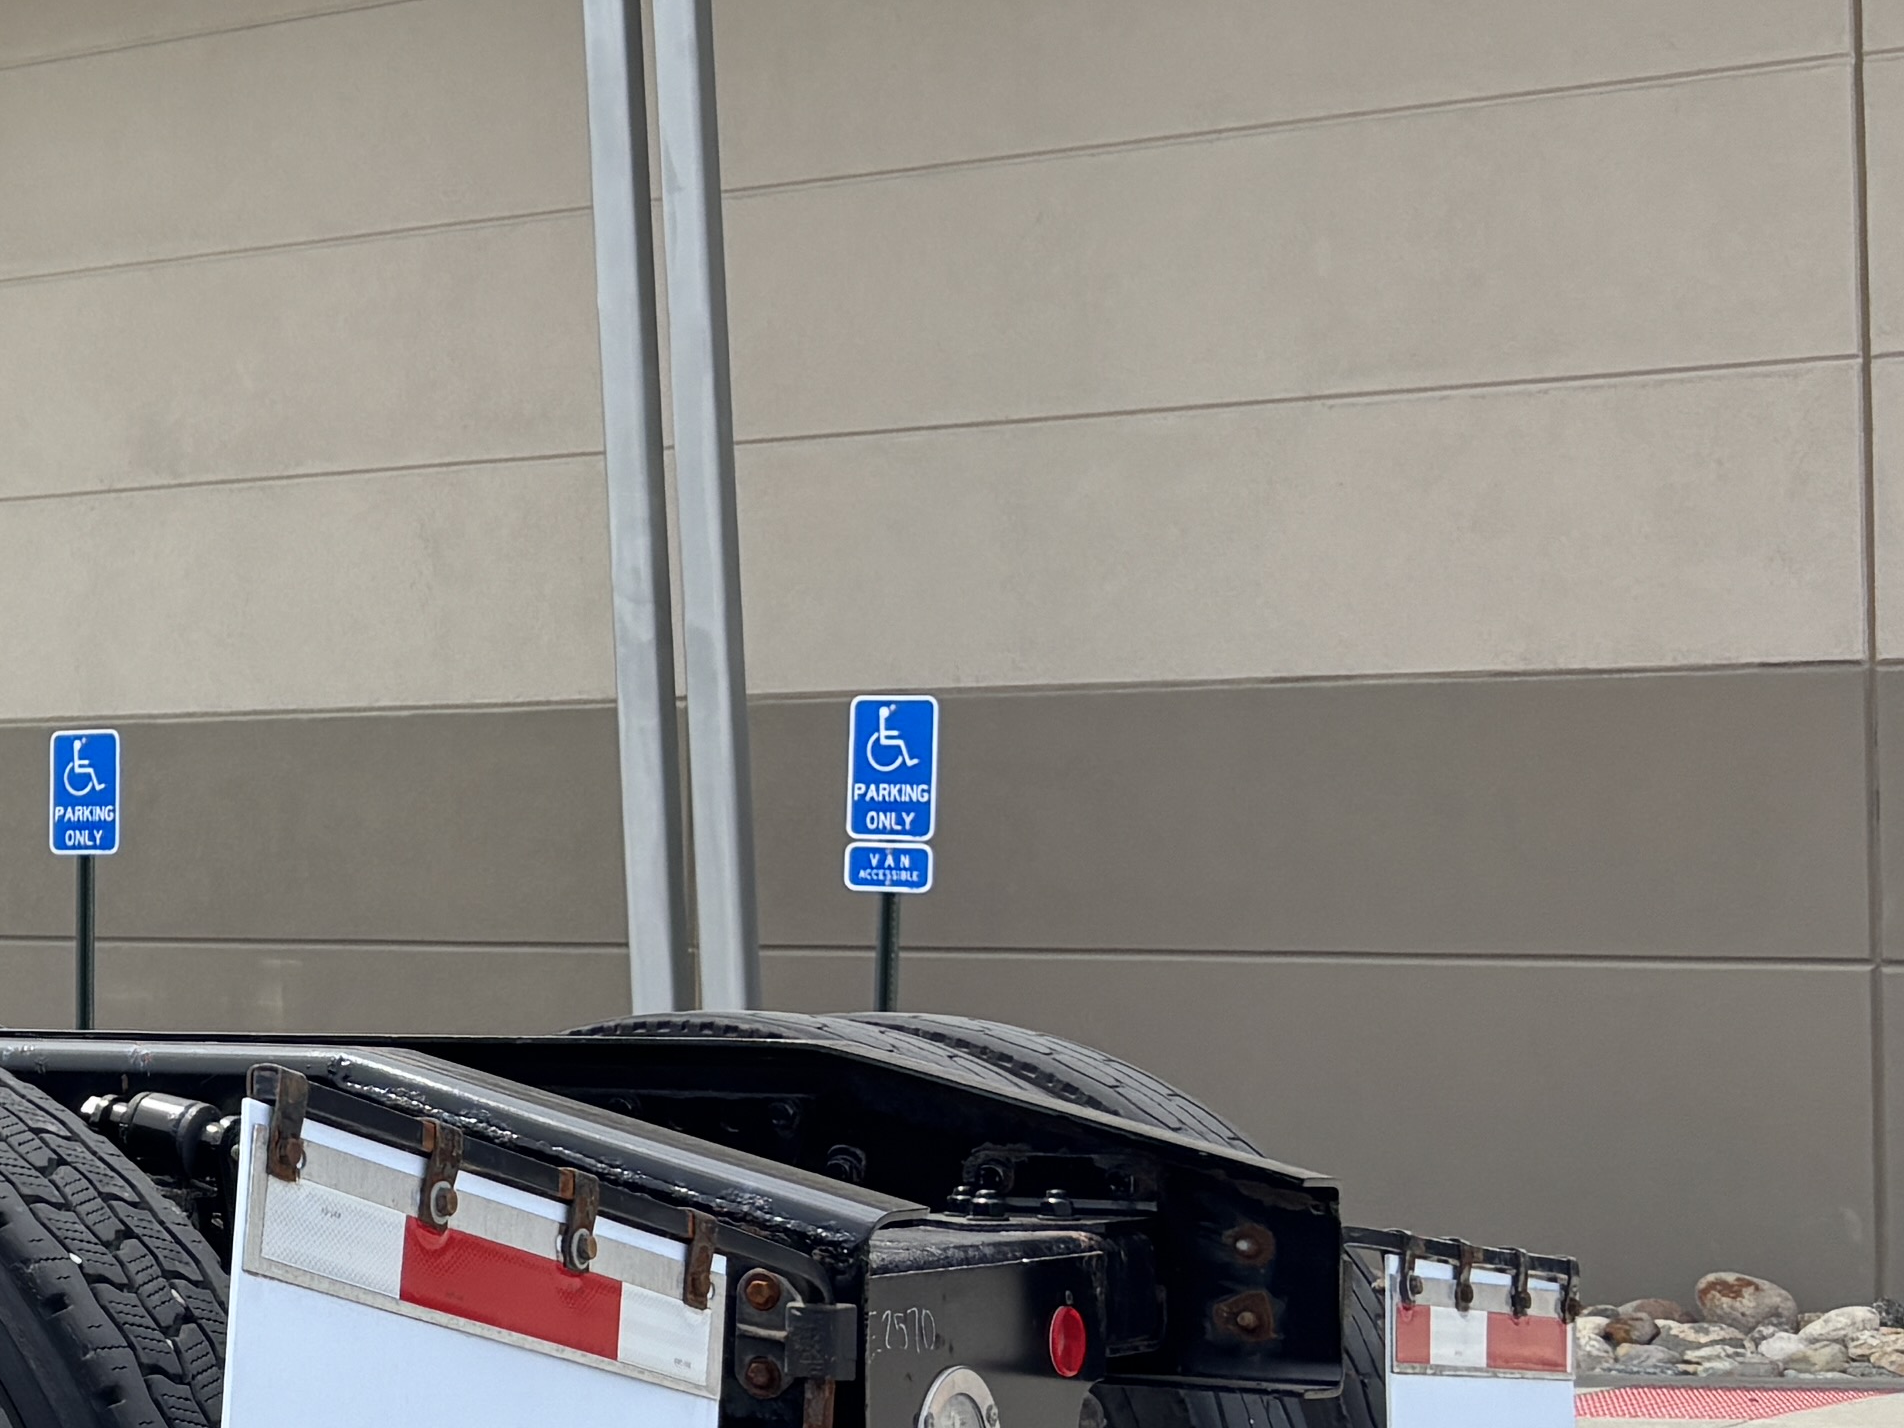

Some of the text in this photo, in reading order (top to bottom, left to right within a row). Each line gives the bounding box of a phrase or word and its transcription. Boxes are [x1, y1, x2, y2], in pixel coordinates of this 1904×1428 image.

[854, 783, 930, 803] PARKING
[55, 805, 114, 822] PARKING
[866, 811, 916, 830] ONLY
[65, 829, 103, 846] ONLY
[870, 852, 910, 868] VAN
[858, 869, 919, 882] ACCESSIBLE
